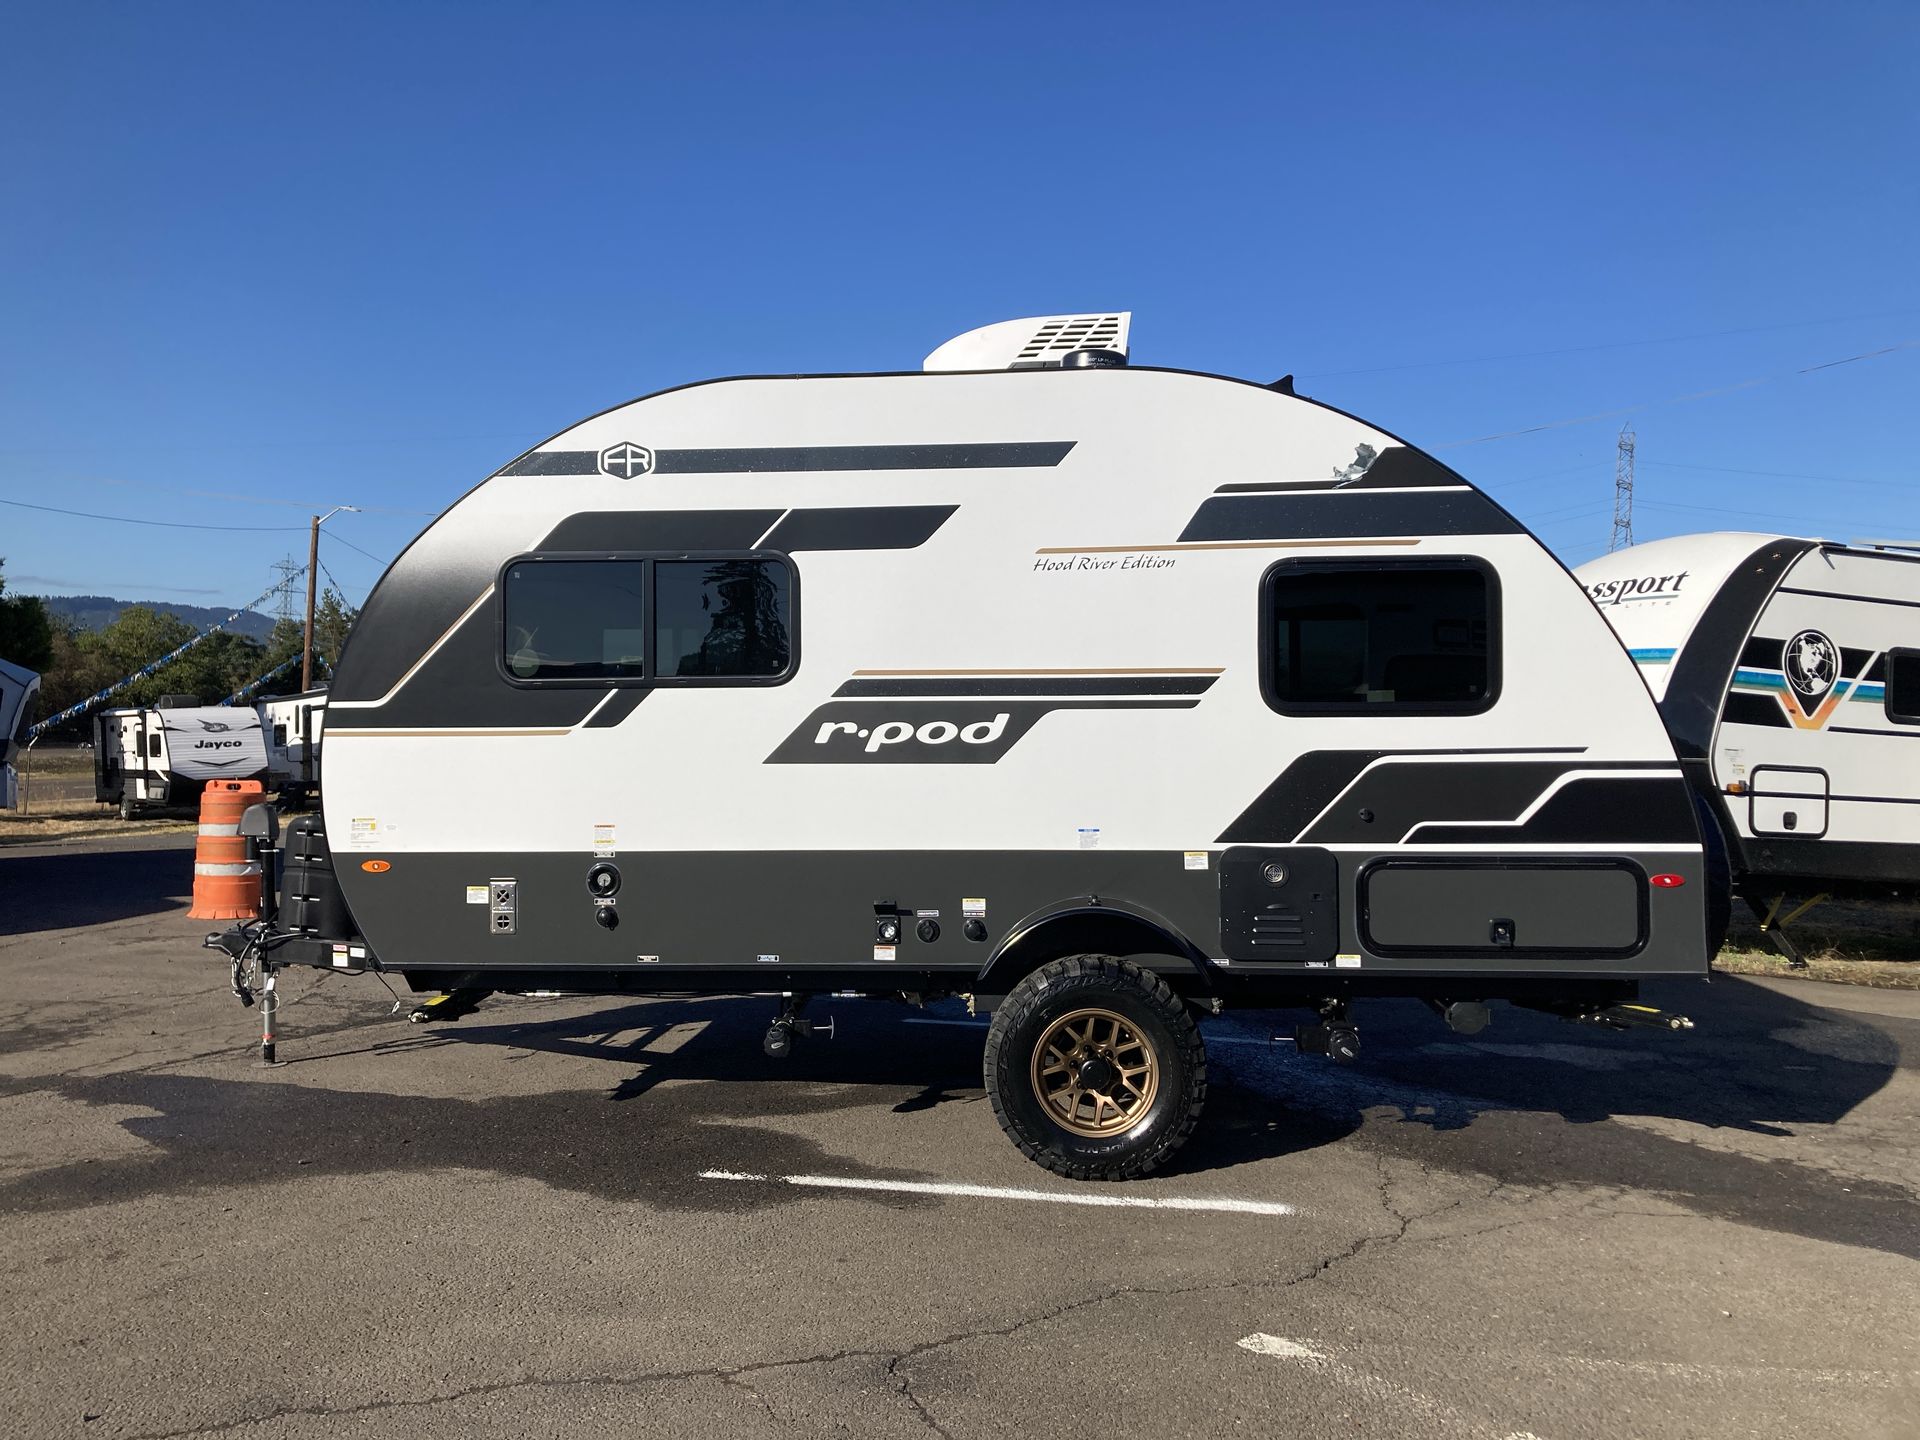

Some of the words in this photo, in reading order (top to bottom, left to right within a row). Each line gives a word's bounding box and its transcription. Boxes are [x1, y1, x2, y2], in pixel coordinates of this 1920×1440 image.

[1033, 555, 1077, 571] Hood
[1077, 557, 1119, 570] River
[1120, 553, 1176, 570] Edition
[1583, 570, 1690, 606] ssport
[194, 740, 242, 750] Jayco
